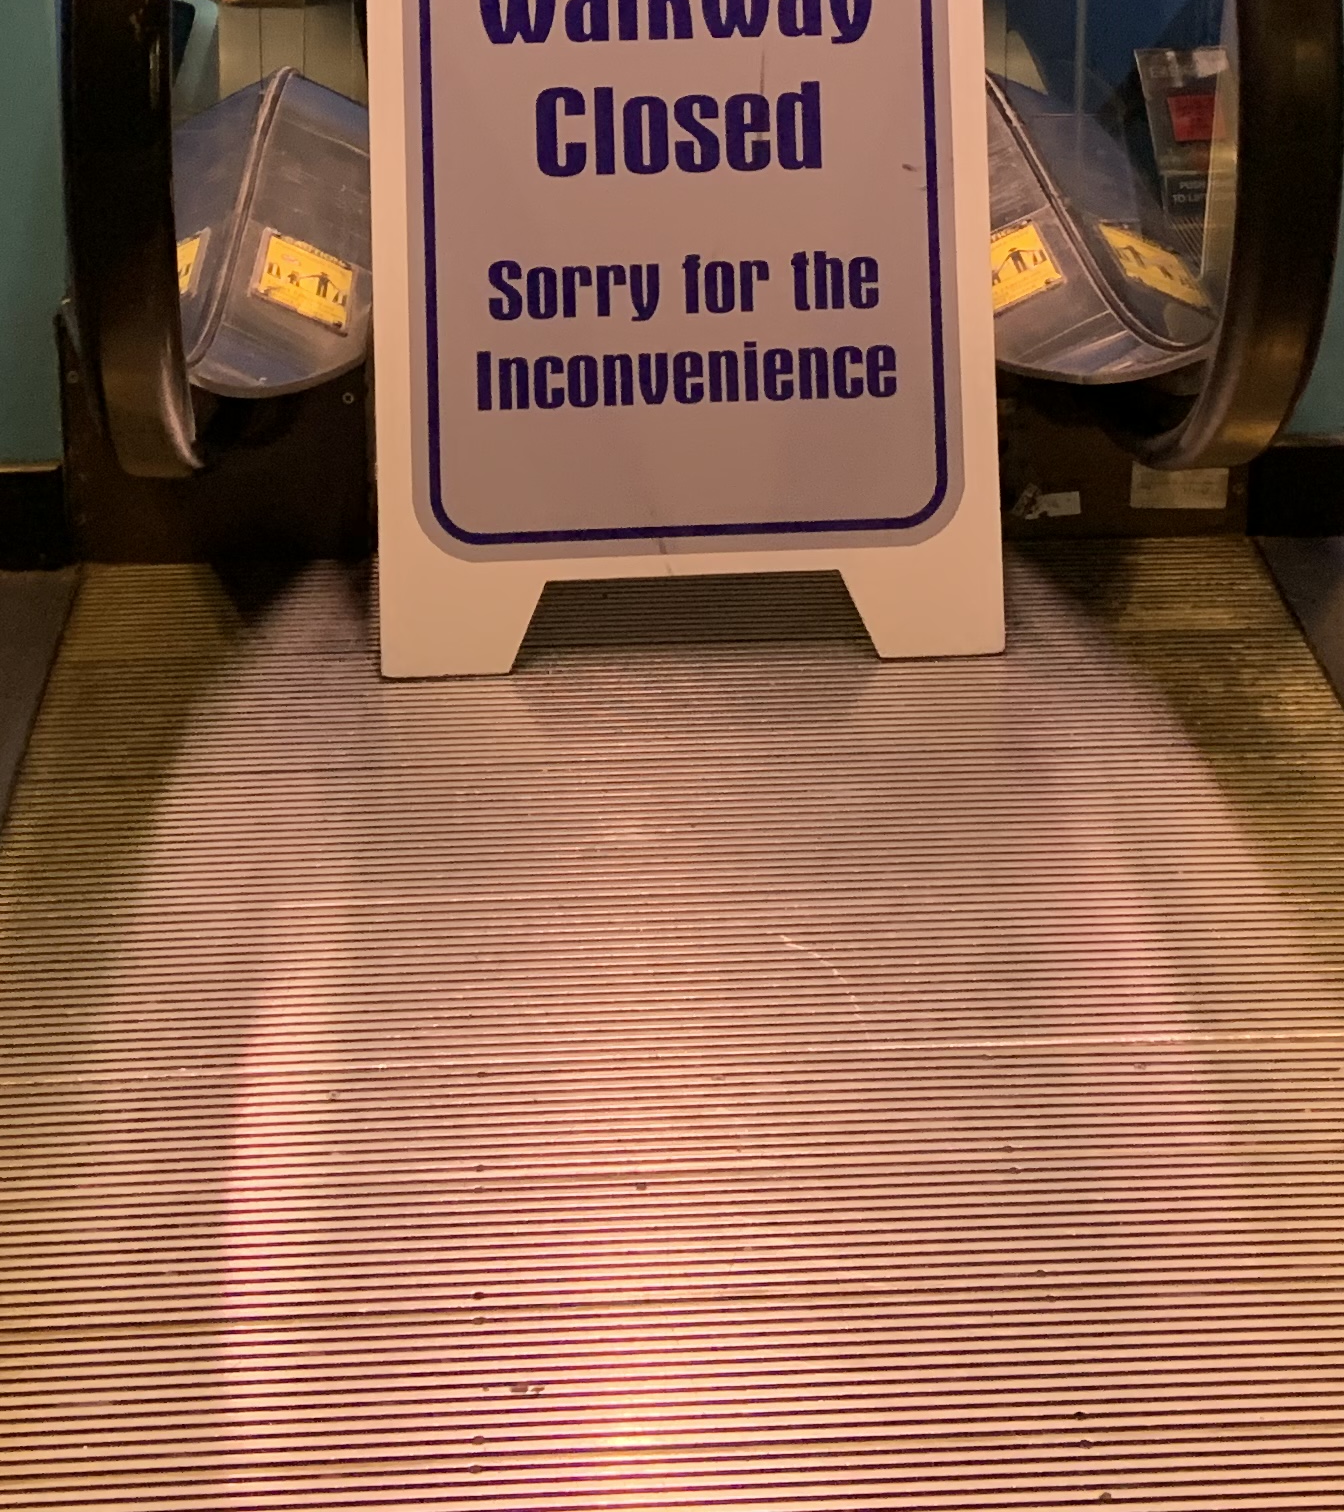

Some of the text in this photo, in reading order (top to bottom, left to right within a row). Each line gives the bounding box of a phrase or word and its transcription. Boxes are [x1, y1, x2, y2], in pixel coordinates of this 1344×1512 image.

[535, 80, 823, 178] Closed
[488, 250, 879, 322] Sorry for the
[476, 341, 897, 411] Inconvenience
